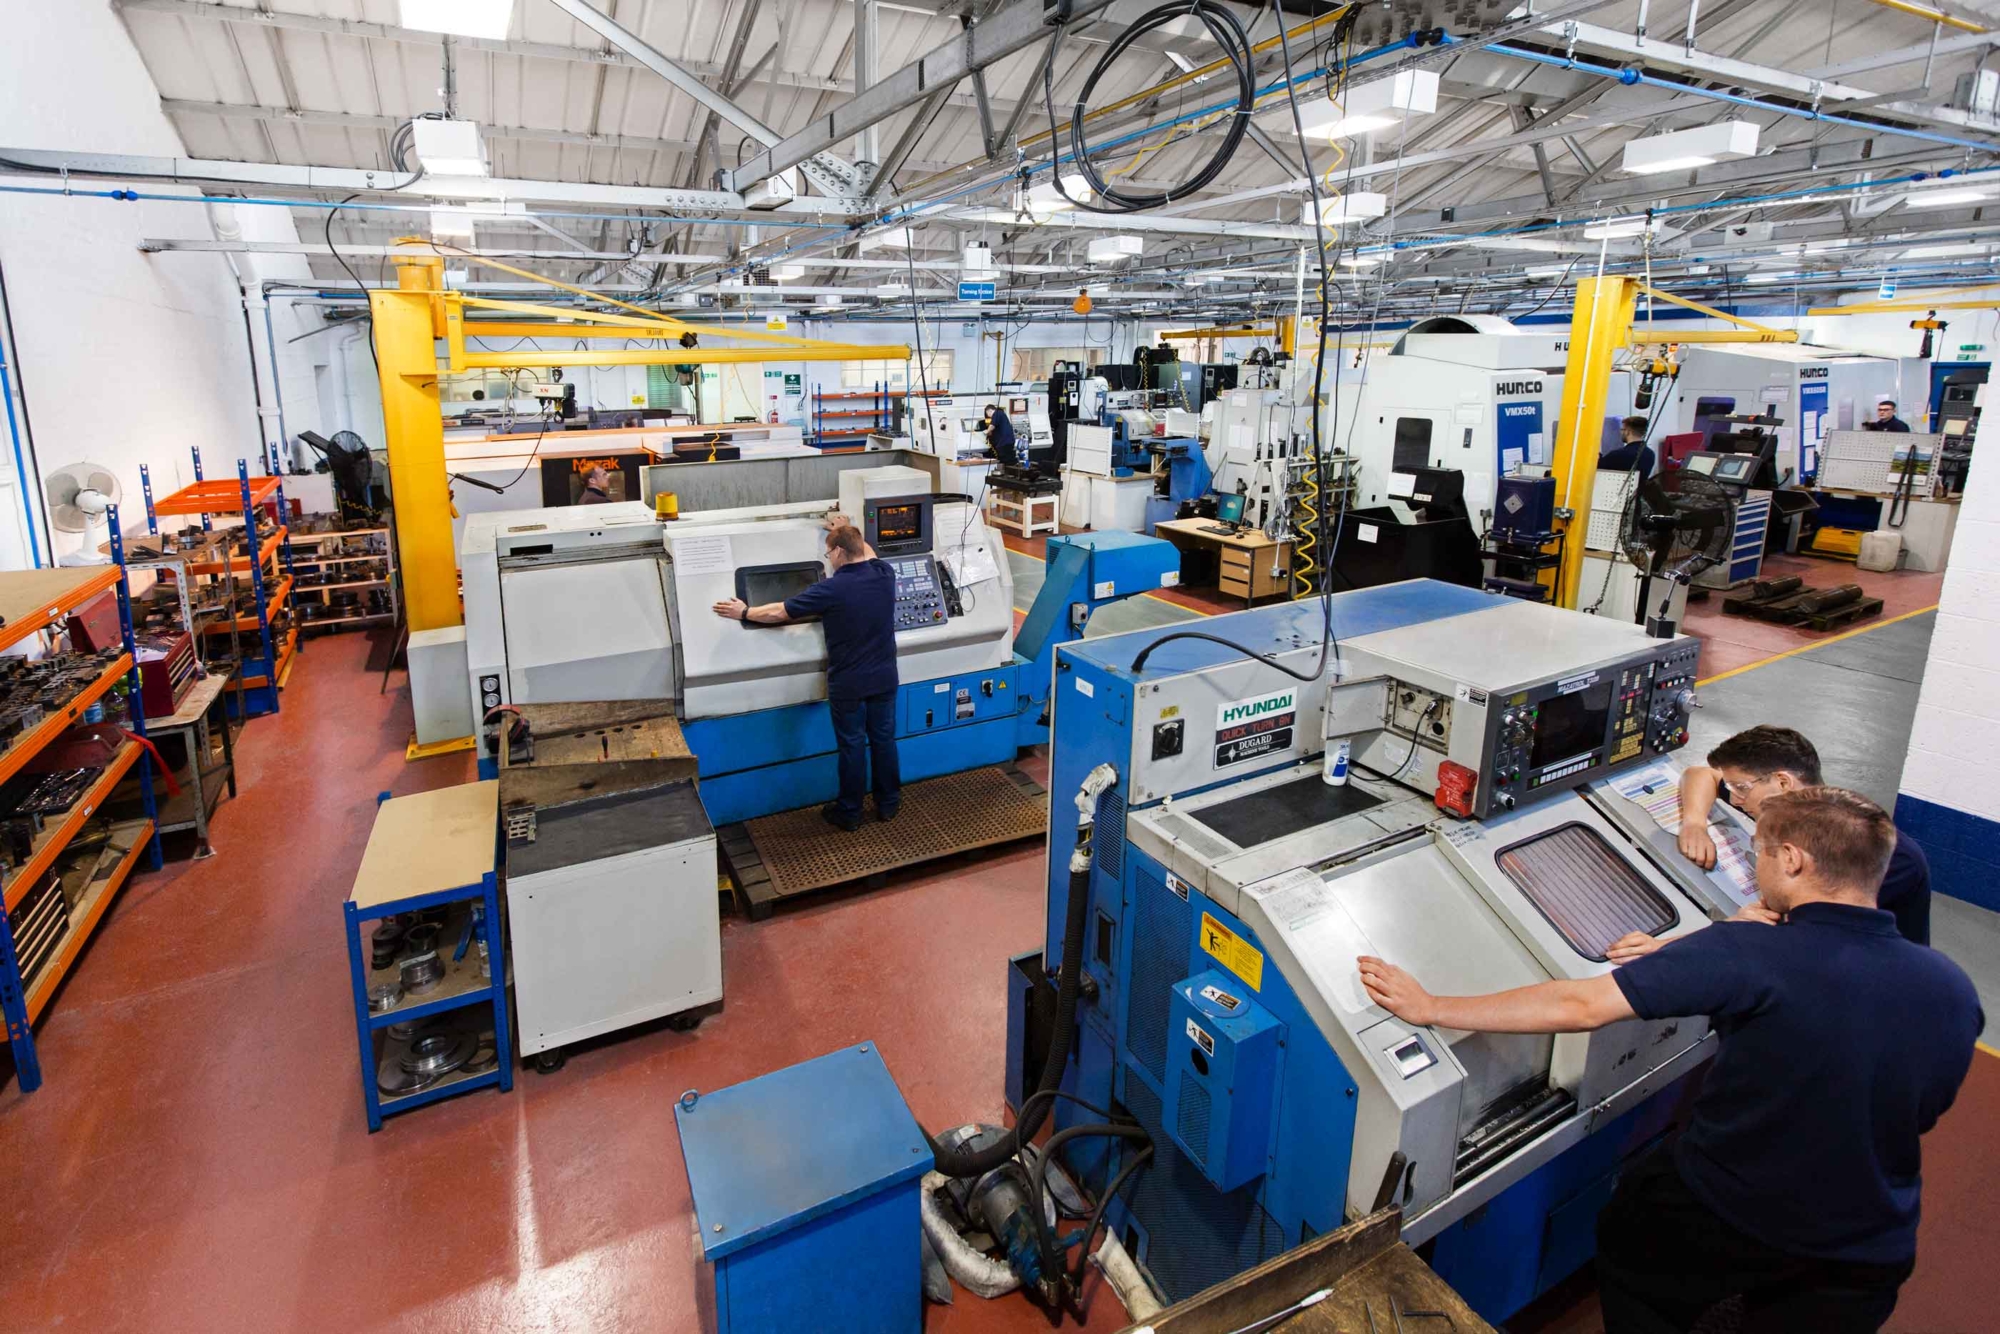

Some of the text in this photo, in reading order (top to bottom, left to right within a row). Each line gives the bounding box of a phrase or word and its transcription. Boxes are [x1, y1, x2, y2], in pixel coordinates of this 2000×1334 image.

[1800, 368, 1828, 378] HURCO
[1496, 381, 1543, 395] HURCO
[1505, 406, 1536, 416] VMX50t
[572, 457, 620, 472] Mzak
[1223, 694, 1292, 722] HYUNDAI
[1222, 726, 1247, 741] QUICK
[1252, 719, 1275, 733] TURN
[1239, 734, 1272, 751] DUGARD
